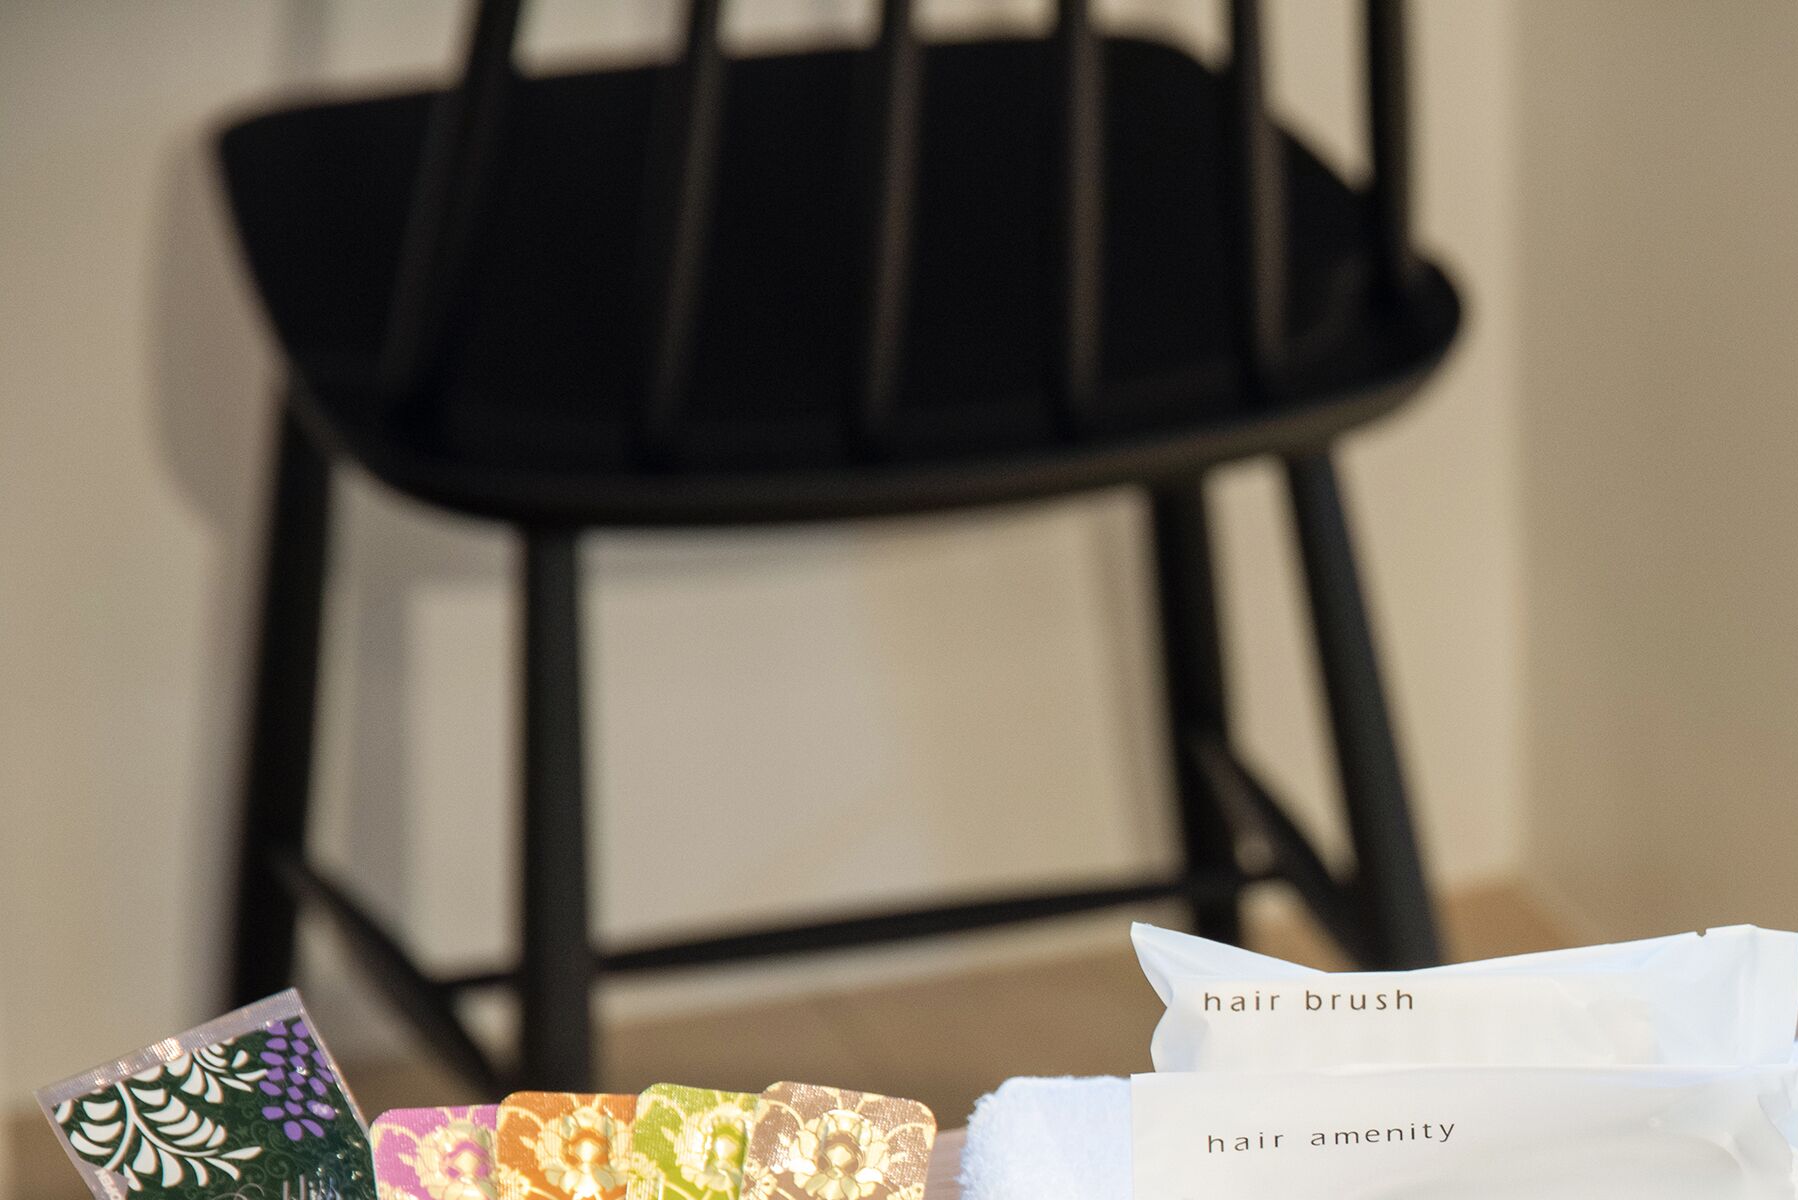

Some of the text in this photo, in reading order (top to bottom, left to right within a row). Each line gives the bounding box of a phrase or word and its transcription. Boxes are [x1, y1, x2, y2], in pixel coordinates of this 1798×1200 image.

[1204, 989, 1414, 1012] hair brush
[1207, 1122, 1456, 1153] hair amenity
